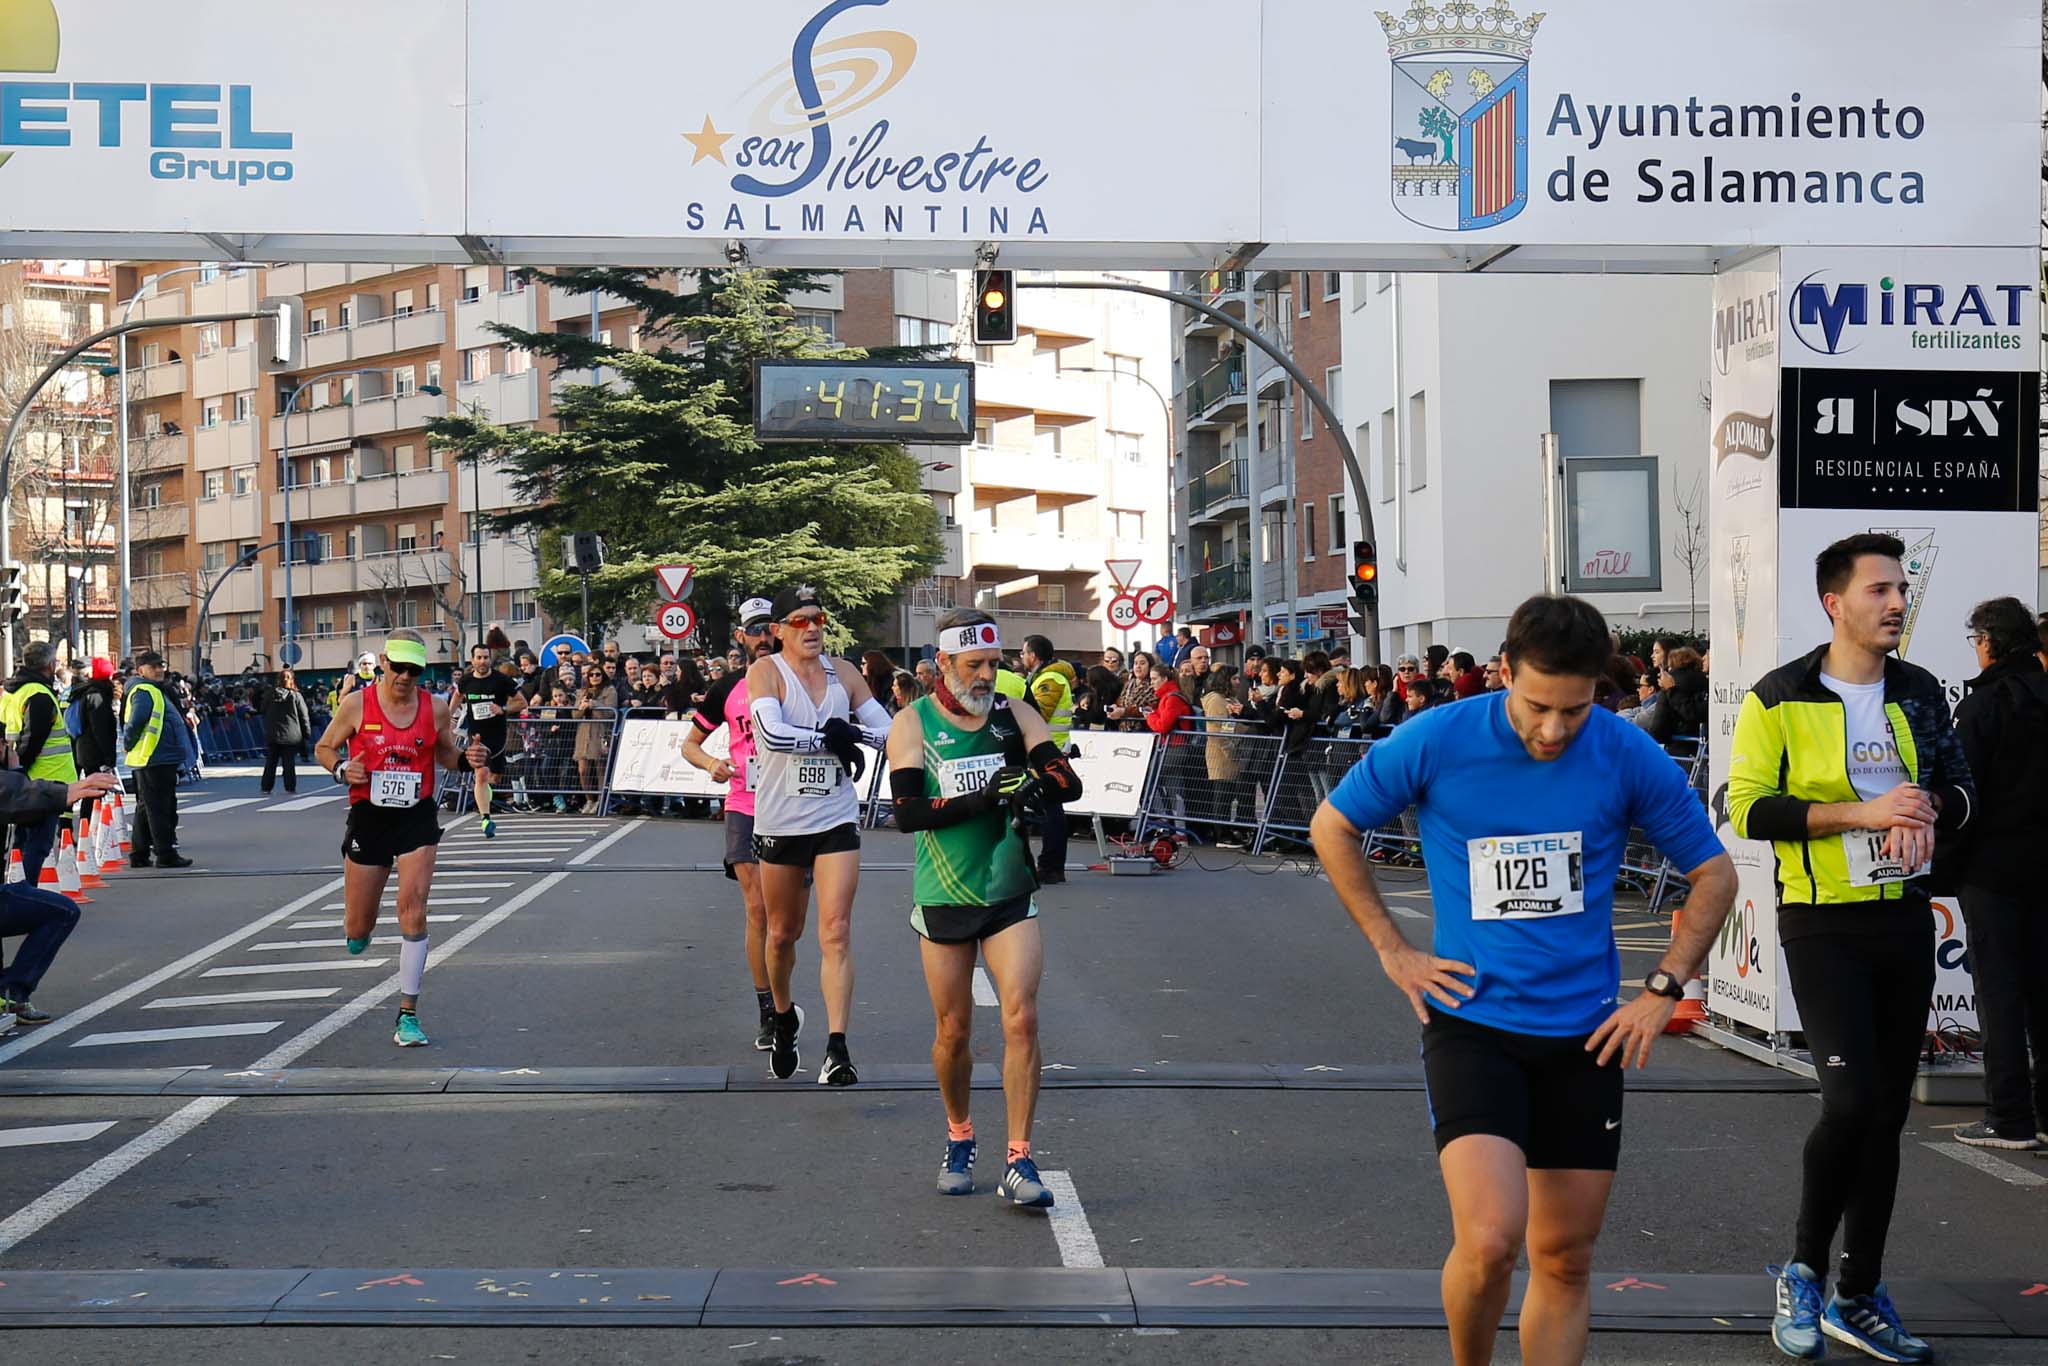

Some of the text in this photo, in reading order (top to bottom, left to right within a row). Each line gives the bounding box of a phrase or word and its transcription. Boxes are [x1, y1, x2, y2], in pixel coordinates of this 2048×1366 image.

[1546, 93, 1925, 150] Ayuntamiento
[150, 152, 294, 186] Grupo
[1547, 156, 1925, 204] de Salamanca
[686, 203, 1049, 234] SALMANTINA
[1911, 331, 2021, 349] fertilizantes
[1724, 421, 1766, 452] ALJOMAR
[1815, 460, 2001, 478] RESIDENCIAL ESPAÑA
[666, 615, 686, 627] 30
[1115, 606, 1135, 619] 30
[1714, 681, 1728, 704] San
[956, 757, 1000, 770] SETEL
[799, 766, 826, 784] 698
[954, 769, 989, 793] 308
[382, 780, 406, 796] 576
[1500, 838, 1571, 855] SETEL
[1495, 857, 1548, 890] 1126
[1507, 900, 1554, 912] ALJOMAR
[1712, 977, 1771, 1013] MERCASALAMANCA
